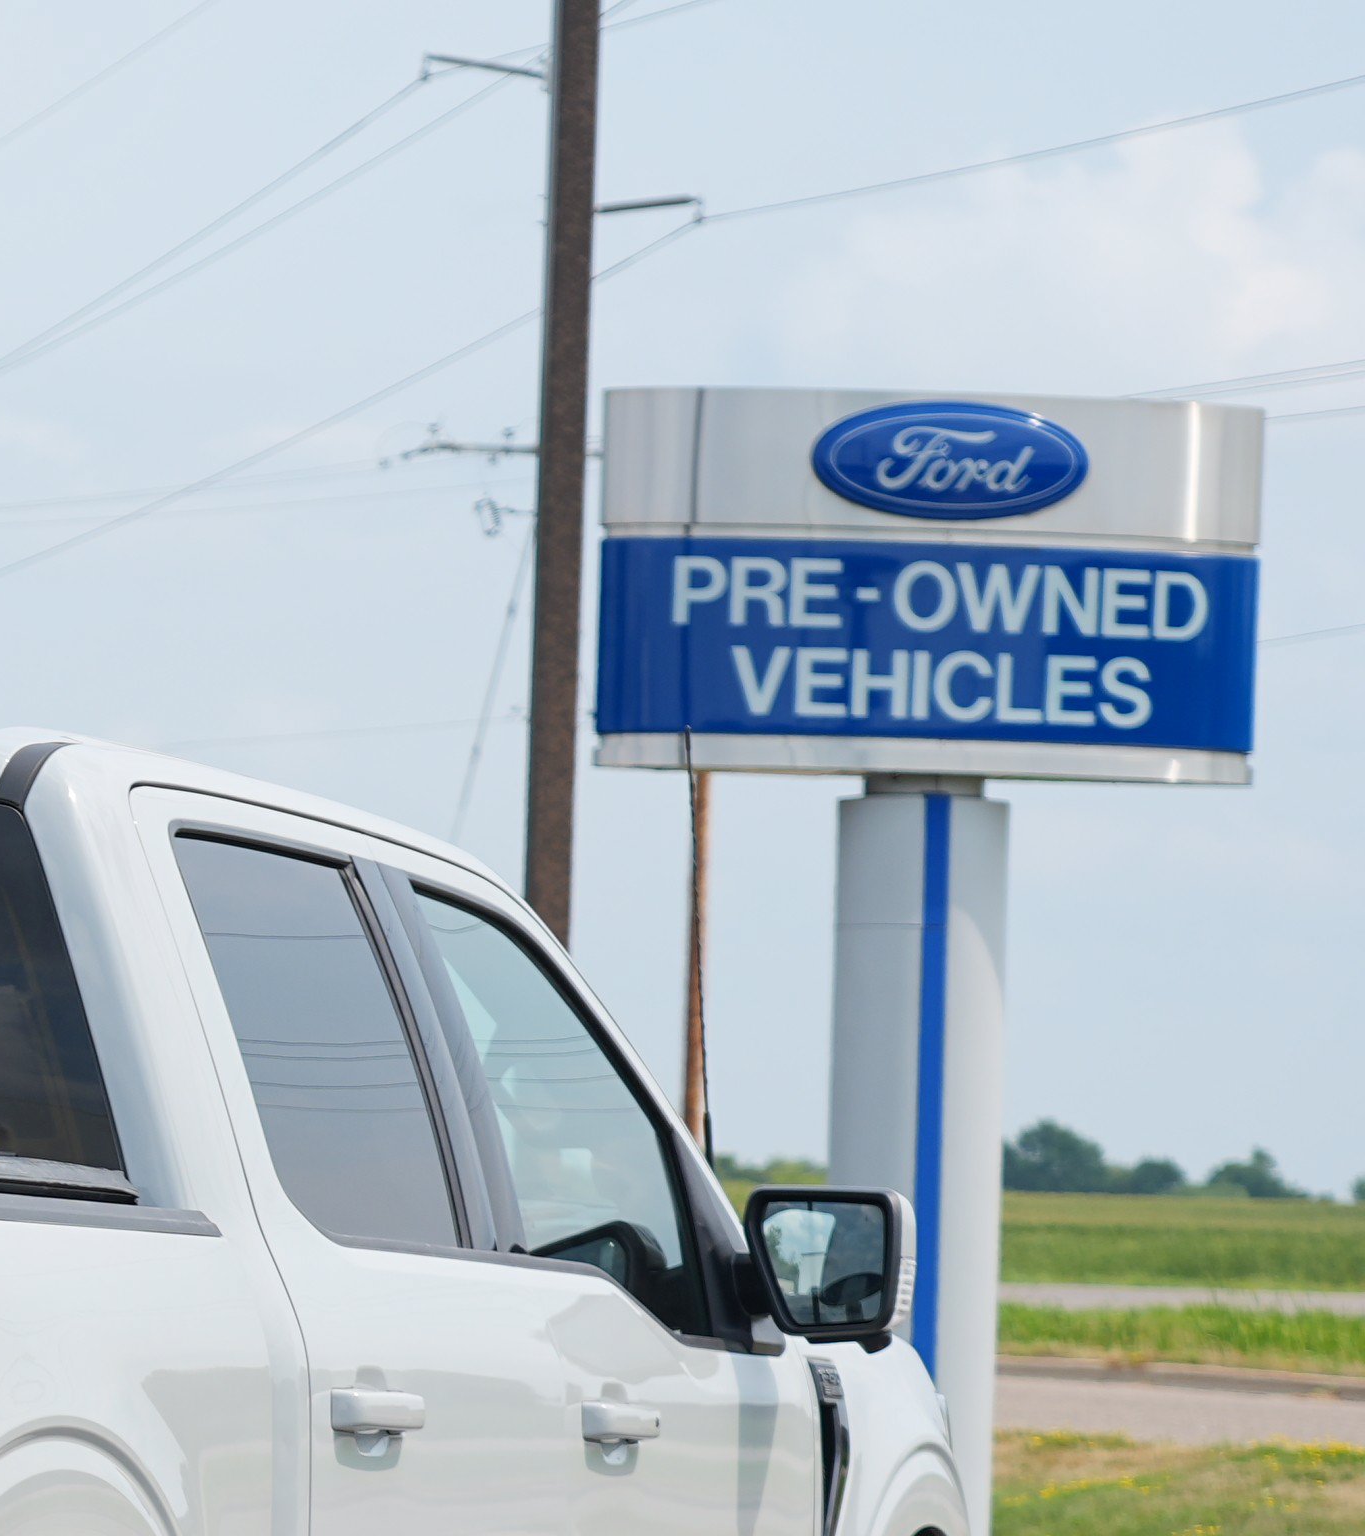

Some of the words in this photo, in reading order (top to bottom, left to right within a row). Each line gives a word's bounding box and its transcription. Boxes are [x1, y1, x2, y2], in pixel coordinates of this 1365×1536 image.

[876, 424, 1037, 492] Ford
[672, 555, 1209, 642] PRE-OWNED
[730, 644, 1153, 730] VEHICLES
